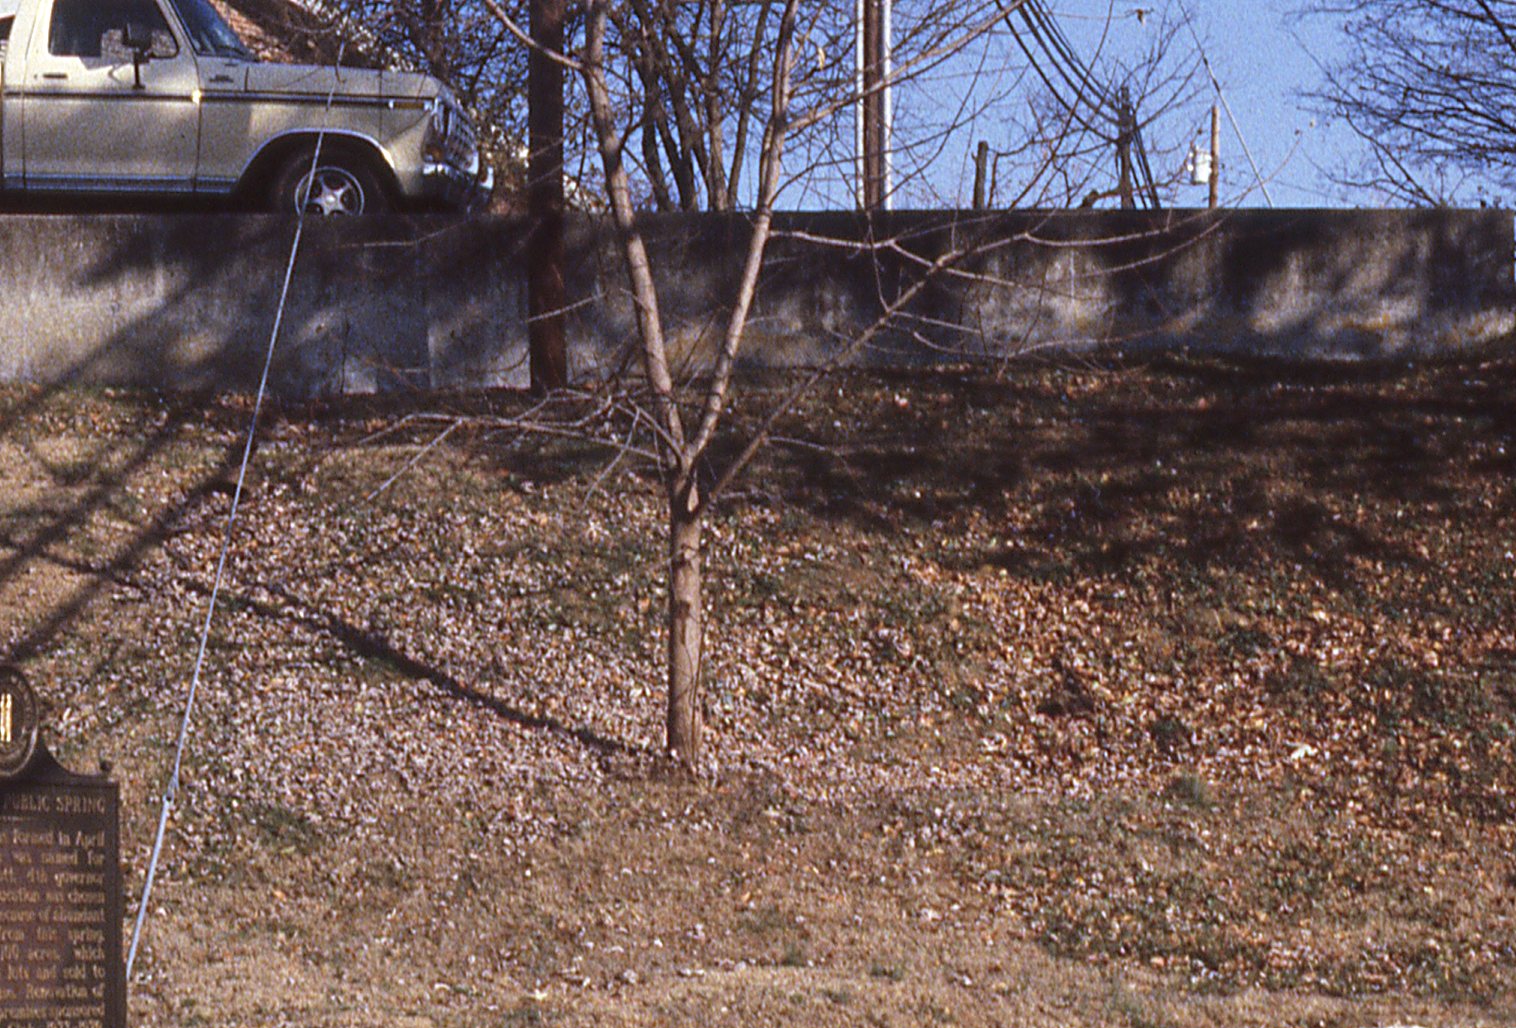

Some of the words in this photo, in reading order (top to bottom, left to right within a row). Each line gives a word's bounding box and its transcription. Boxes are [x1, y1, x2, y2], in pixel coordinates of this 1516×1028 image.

[56, 794, 105, 814] SPRING
[58, 830, 70, 846] in
[75, 830, 105, 849] April
[87, 849, 104, 865] for
[54, 873, 104, 887] governor
[38, 907, 50, 922] of
[73, 945, 105, 961] which
[36, 964, 57, 979] and
[63, 964, 86, 979] sold
[92, 964, 105, 979] to
[92, 980, 105, 998] of
